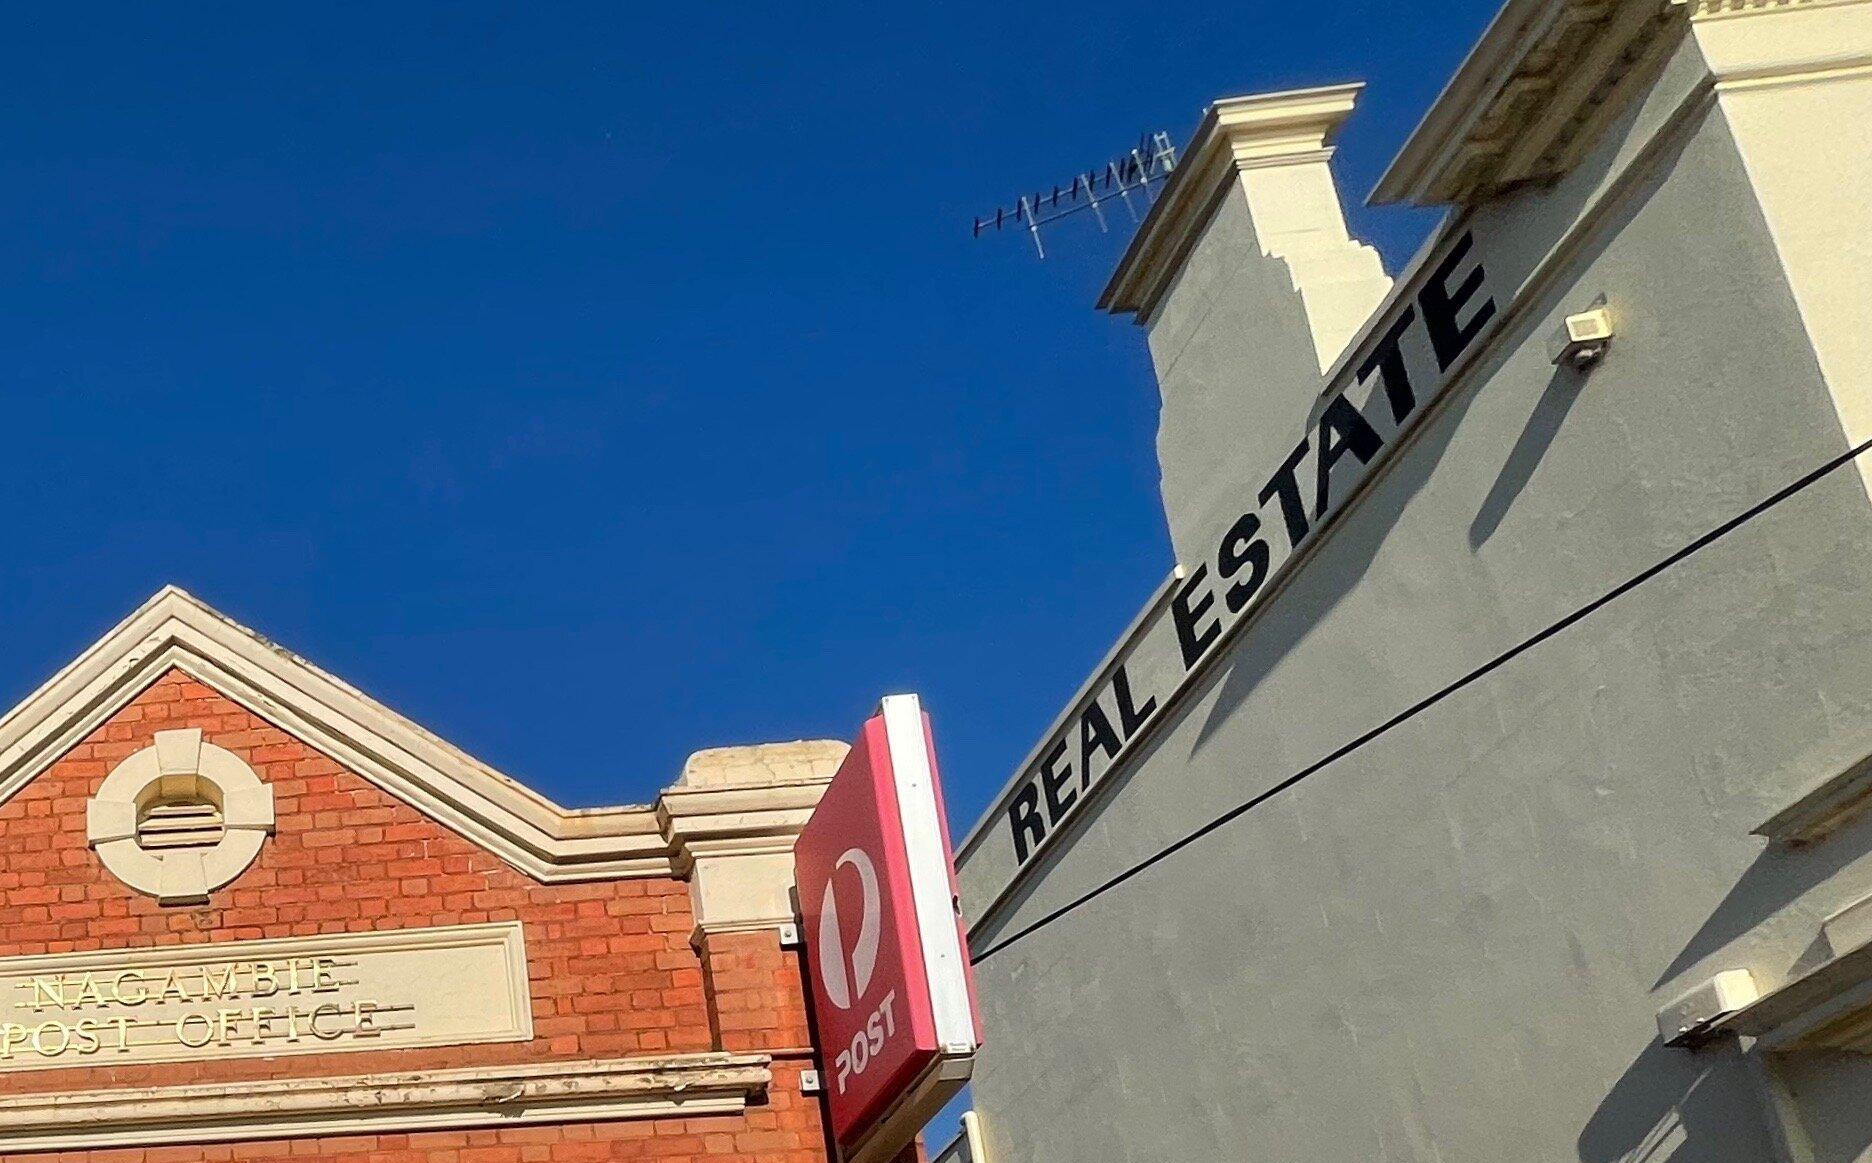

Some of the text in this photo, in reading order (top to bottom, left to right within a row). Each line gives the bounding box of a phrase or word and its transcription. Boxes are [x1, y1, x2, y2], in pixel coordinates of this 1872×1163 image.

[1007, 231, 1496, 866] REAL ESTATE
[31, 957, 340, 1013] NAGAMBIE
[1, 1000, 381, 1059] POST OFFICE
[835, 988, 896, 1095] POST
